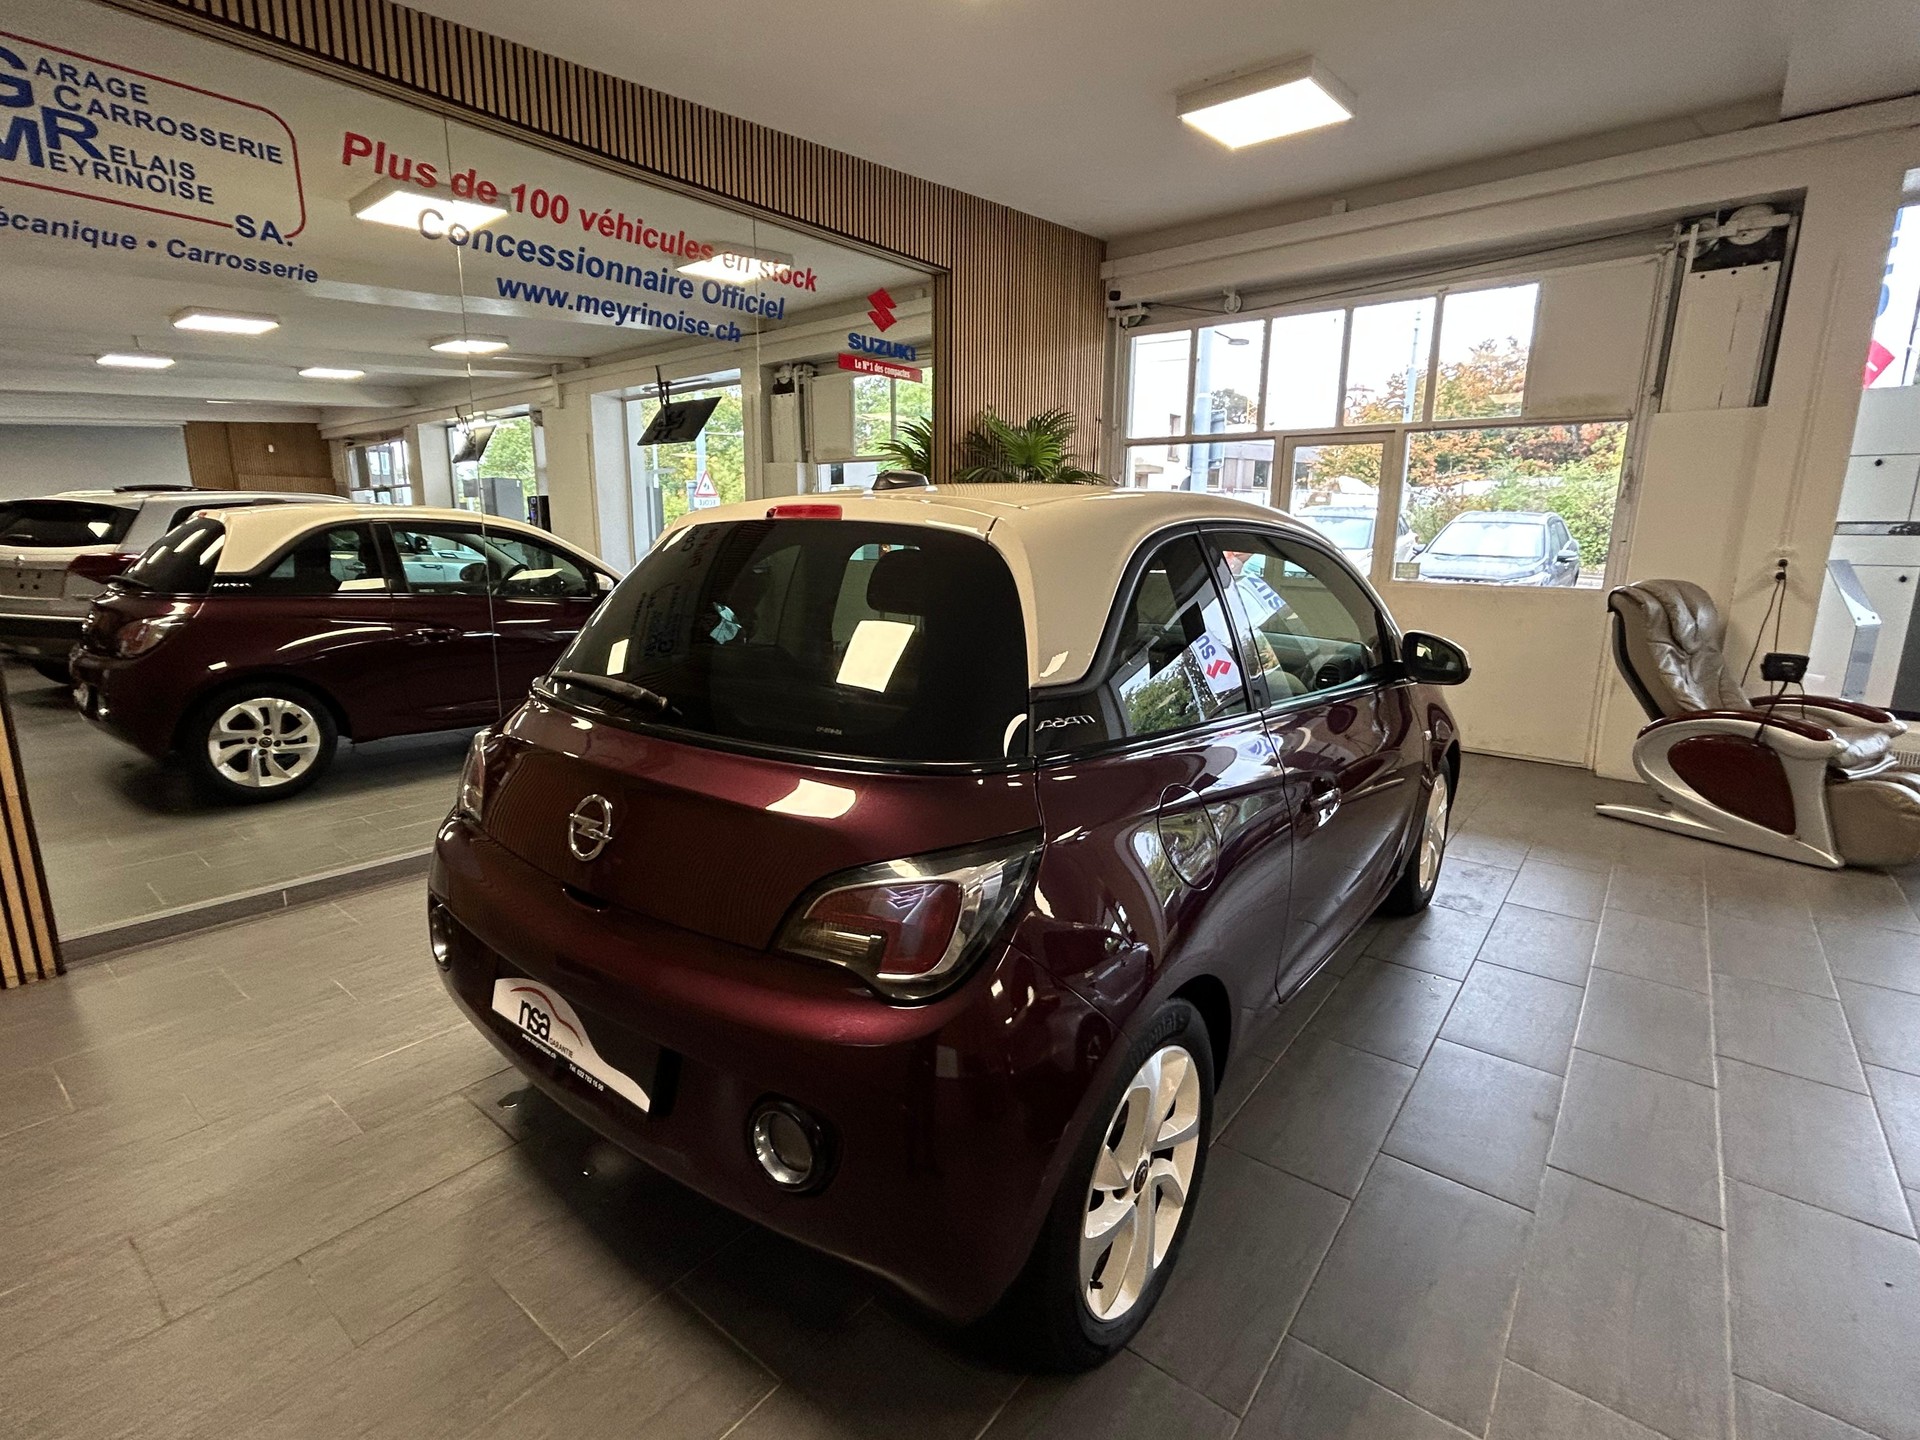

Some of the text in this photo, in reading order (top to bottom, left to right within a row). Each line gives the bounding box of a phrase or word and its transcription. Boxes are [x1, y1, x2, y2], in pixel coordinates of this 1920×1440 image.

[54, 84, 283, 164] CARROSSERIE
[342, 131, 818, 292] Plus de 100 véhicules en stock
[167, 239, 318, 283] Carrosserie
[418, 208, 785, 320] Concessionnaire Officiel
[496, 277, 741, 342] www.meyrinoise.ch
[848, 332, 916, 361] SUZUKI
[854, 359, 862, 369] Le
[874, 363, 884, 373] des
[884, 366, 911, 378] compactes
[518, 999, 550, 1042] nsa
[549, 1037, 574, 1059] GARANTIE
